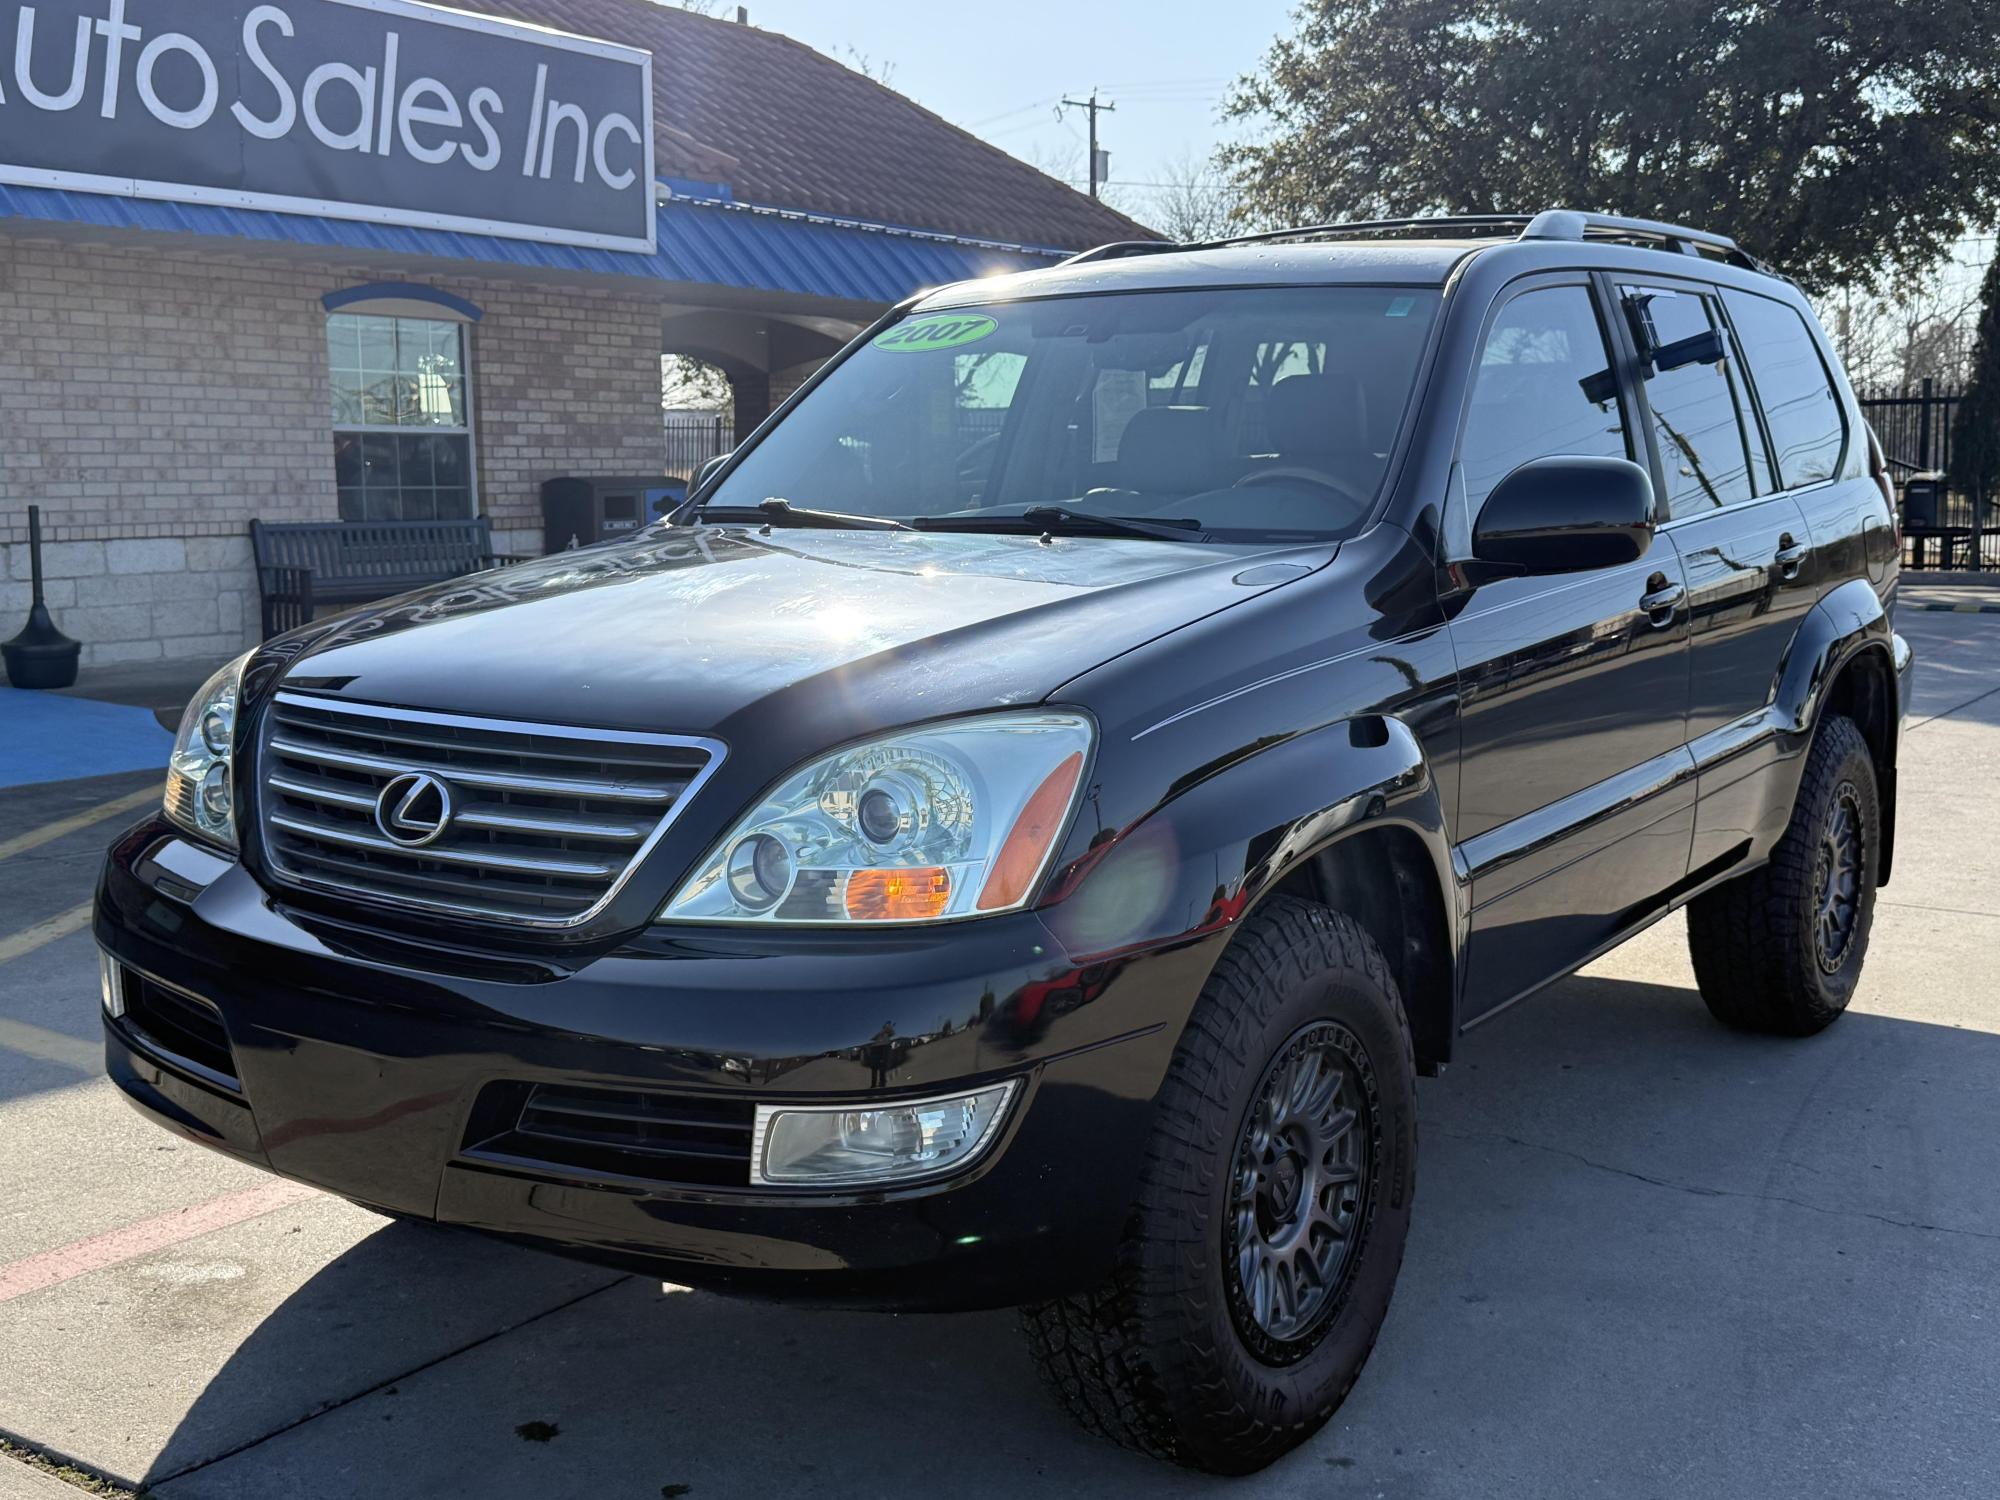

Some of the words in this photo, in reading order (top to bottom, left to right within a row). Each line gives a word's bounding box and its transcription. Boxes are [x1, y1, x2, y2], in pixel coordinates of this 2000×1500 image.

[0, 0, 218, 129] uto
[230, 5, 503, 171] Sales
[522, 63, 641, 190] Inc
[878, 319, 990, 345] 2007
